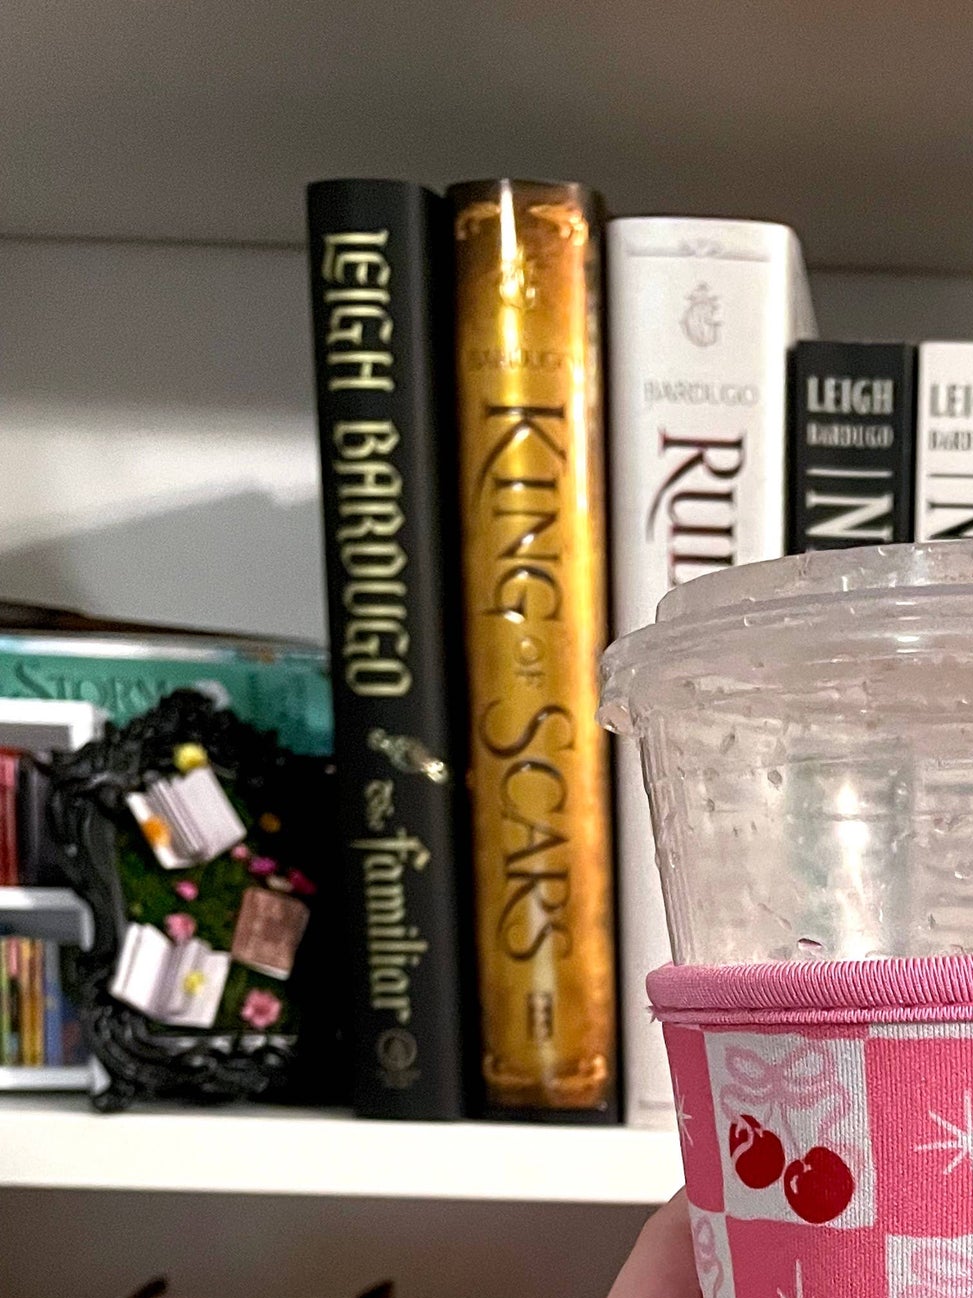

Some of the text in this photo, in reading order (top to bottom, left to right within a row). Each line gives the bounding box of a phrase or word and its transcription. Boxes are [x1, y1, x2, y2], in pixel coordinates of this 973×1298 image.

[322, 229, 413, 697] LEIGH BARDUGO
[806, 422, 894, 448] BARDUGO
[807, 376, 894, 414] LEIGH
[477, 404, 566, 624] KING
[479, 700, 576, 962] SCARS
